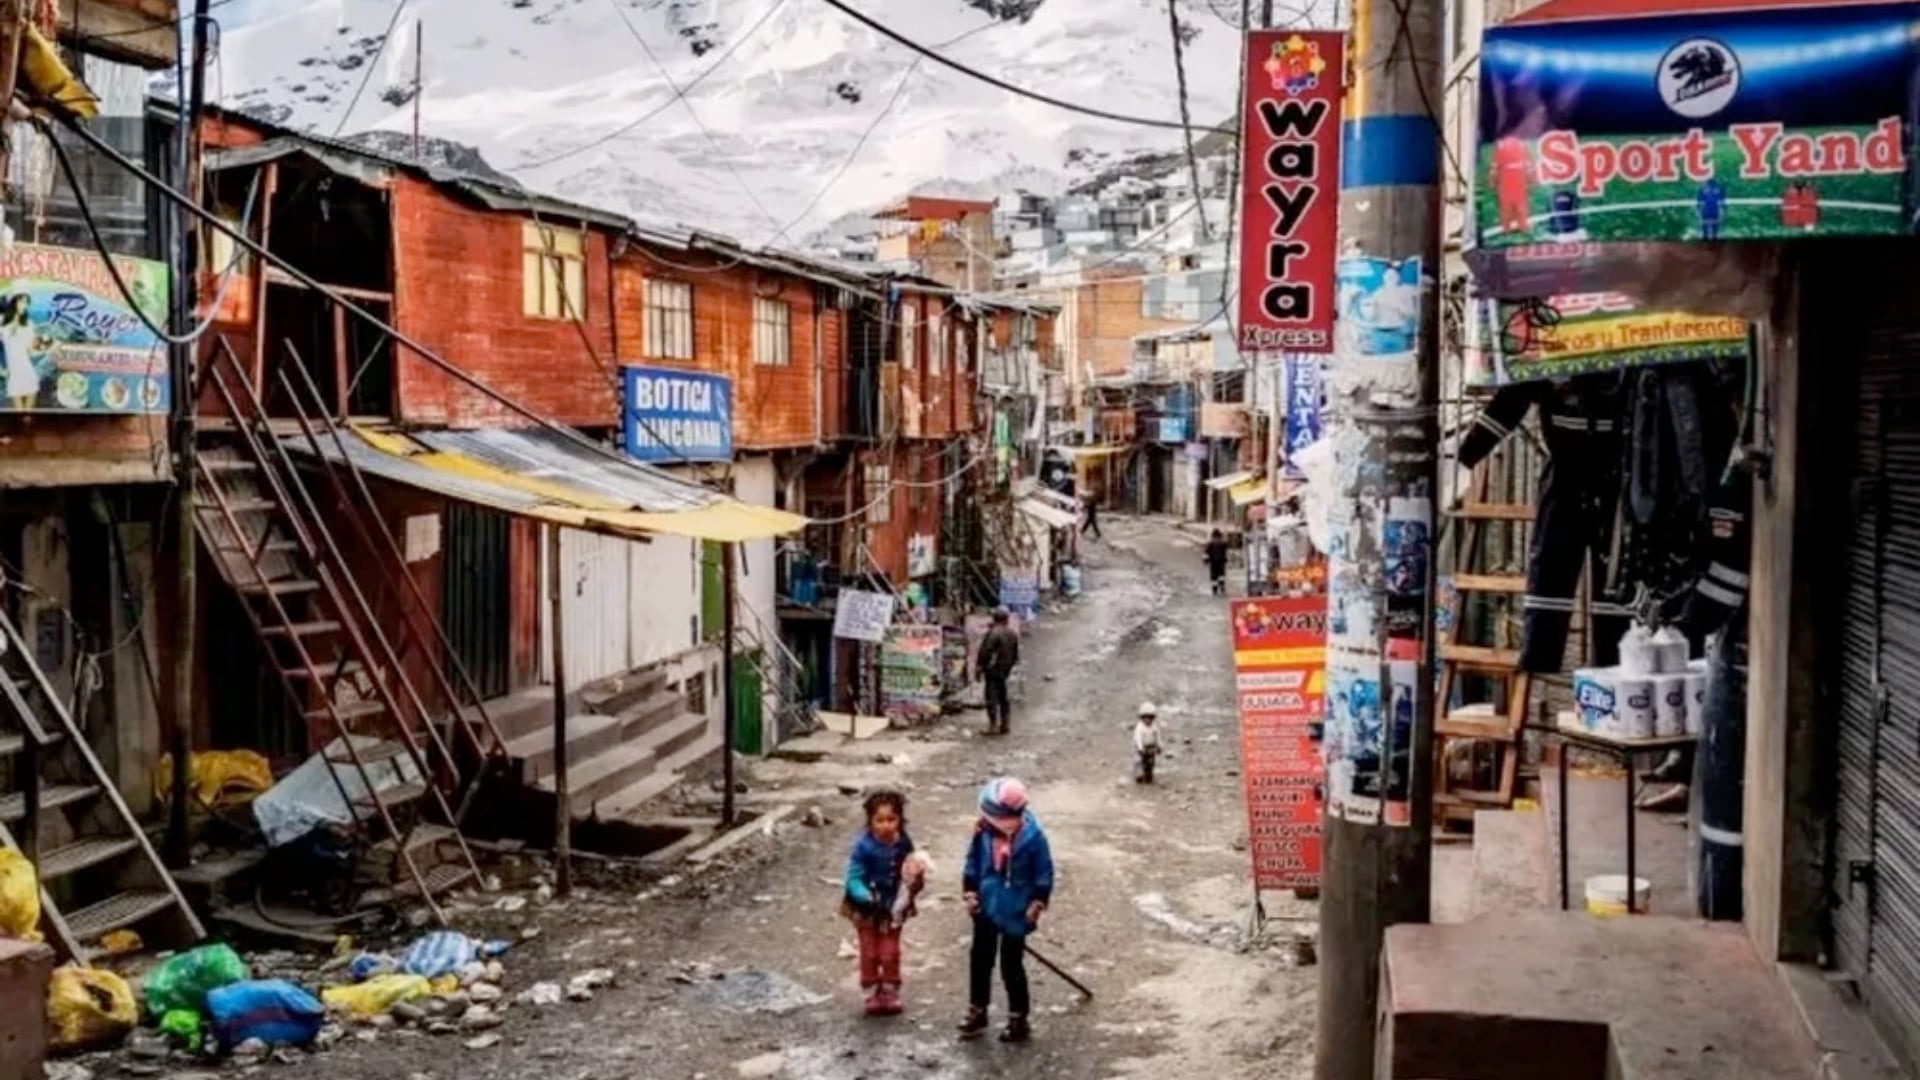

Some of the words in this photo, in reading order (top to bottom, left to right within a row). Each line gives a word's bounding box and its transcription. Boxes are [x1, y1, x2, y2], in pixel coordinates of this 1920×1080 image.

[1537, 128, 1713, 198] Sport
[1730, 116, 1906, 179] Yand
[1256, 98, 1329, 322] wayra
[0, 250, 136, 304] RESTAURA
[1244, 326, 1326, 347] Xpress
[636, 376, 711, 413] BOTICA
[1292, 353, 1315, 449] ENTA
[1272, 611, 1326, 635] way
